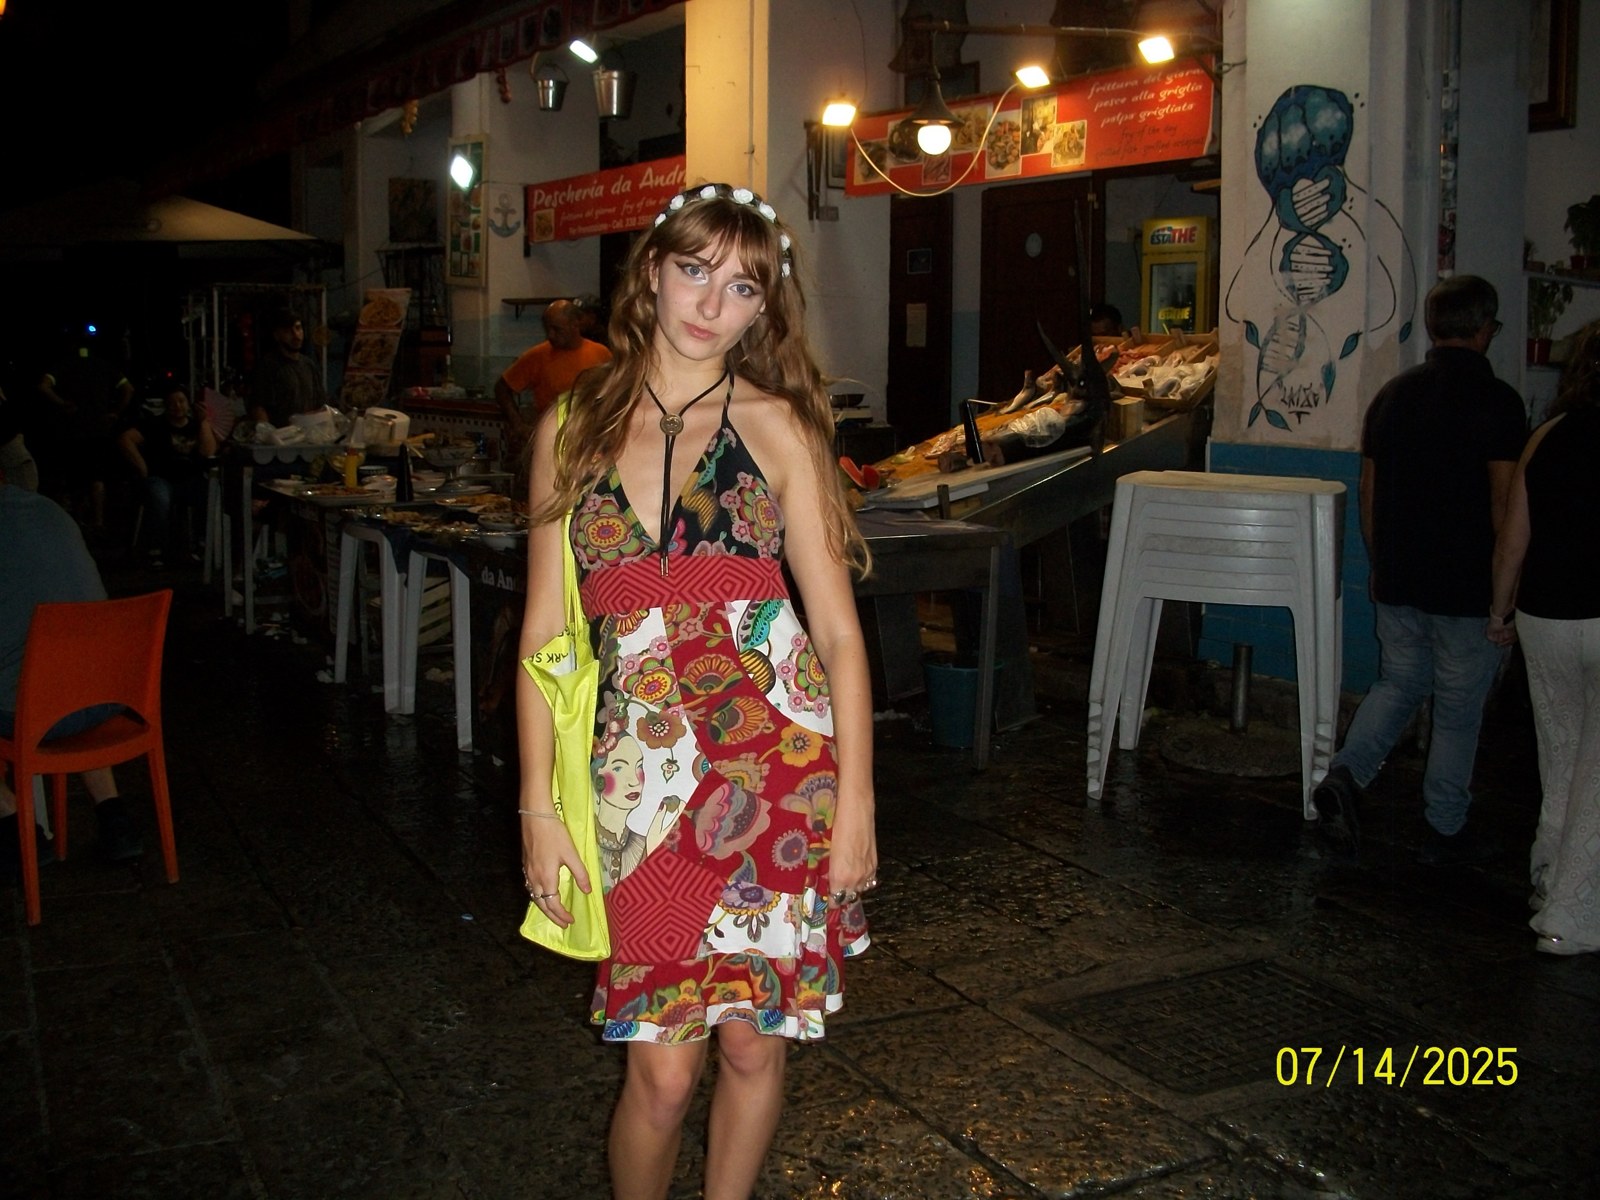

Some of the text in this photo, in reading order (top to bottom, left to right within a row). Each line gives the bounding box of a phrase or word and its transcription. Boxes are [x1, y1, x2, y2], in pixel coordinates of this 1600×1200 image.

[1087, 79, 1139, 99] frittura
[1143, 73, 1162, 85] del
[1094, 82, 1203, 112] pesce alla griglia
[1100, 102, 1195, 128] polpo grigliato
[533, 179, 604, 209] Pescheria
[611, 174, 632, 195] da
[480, 565, 496, 587] da
